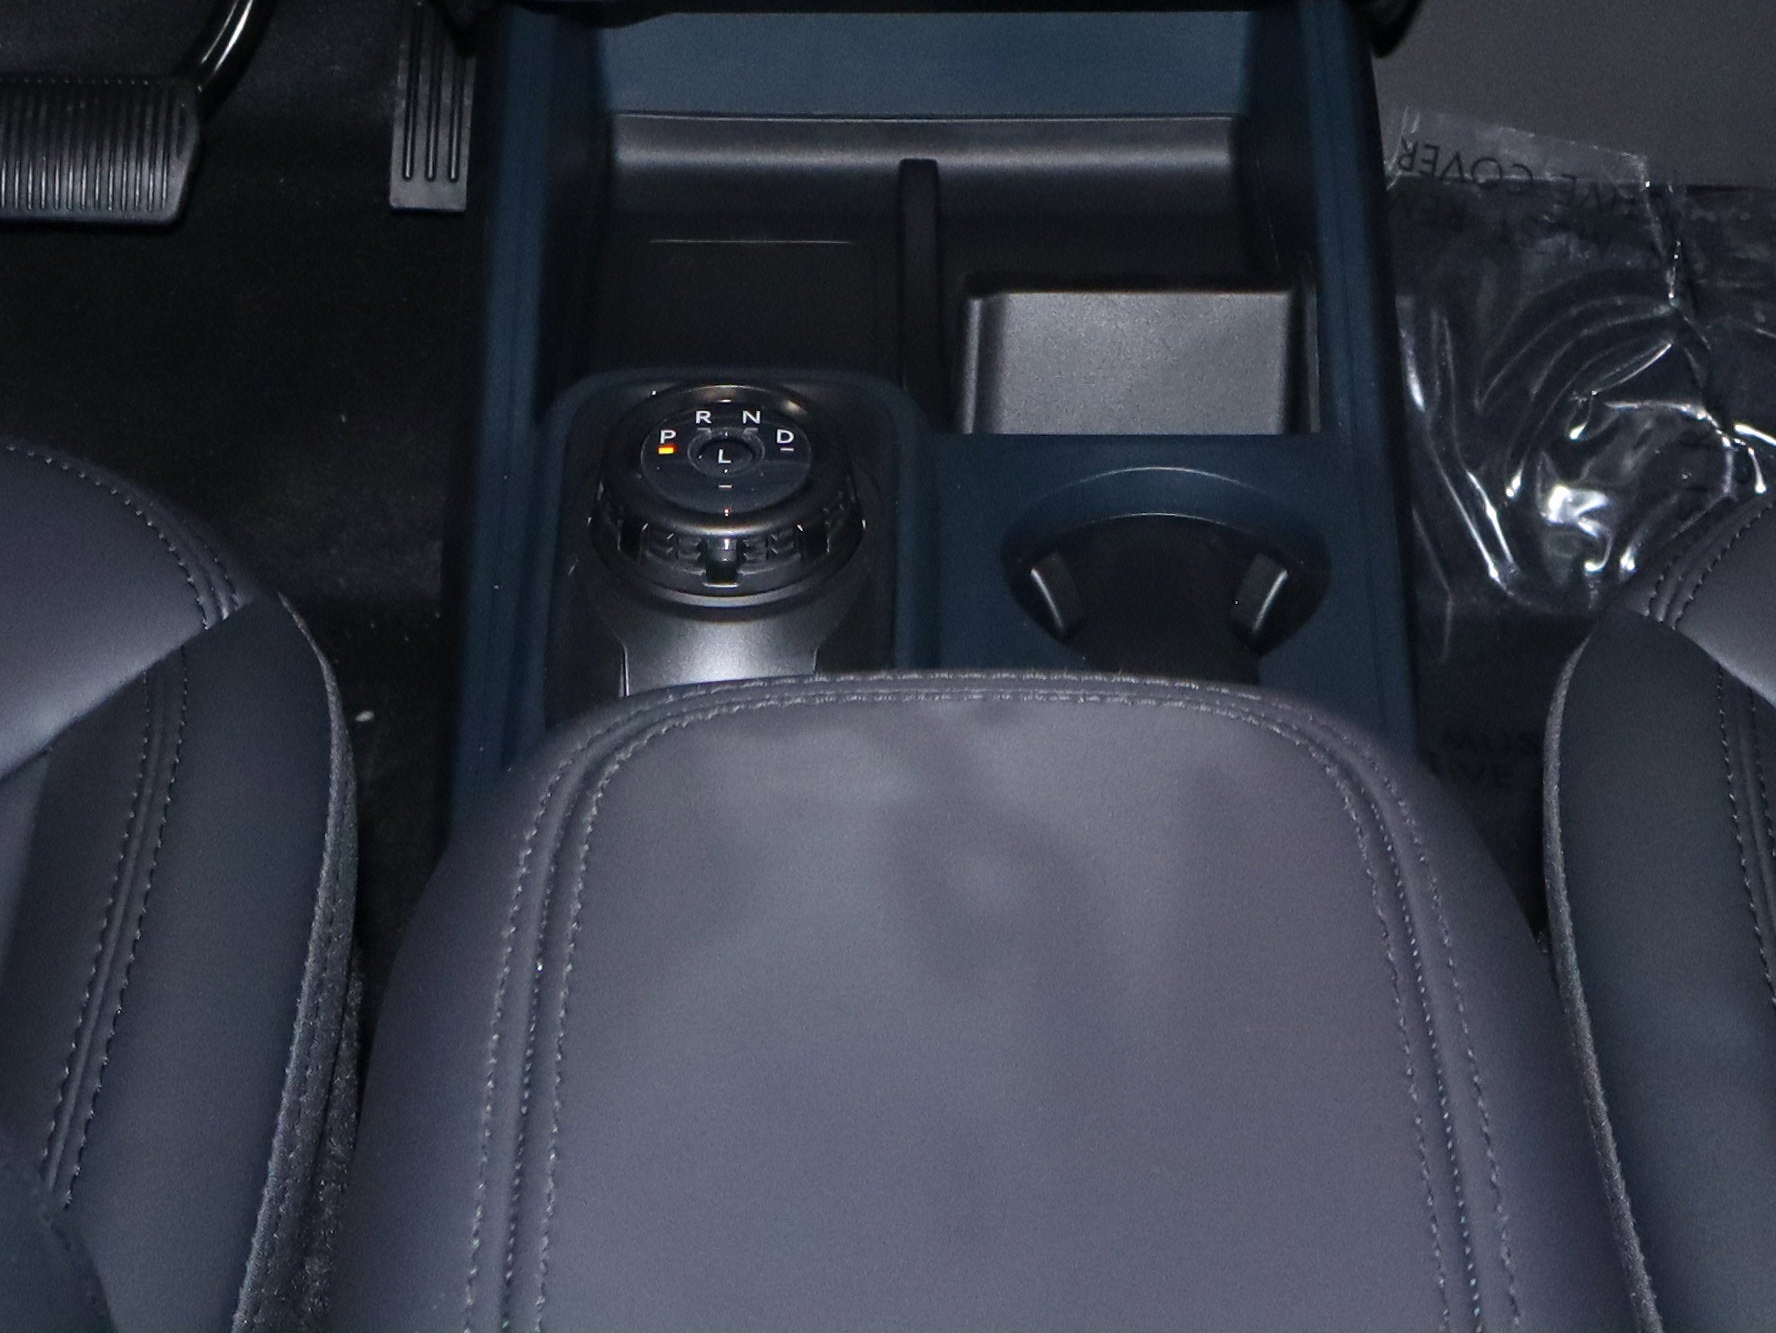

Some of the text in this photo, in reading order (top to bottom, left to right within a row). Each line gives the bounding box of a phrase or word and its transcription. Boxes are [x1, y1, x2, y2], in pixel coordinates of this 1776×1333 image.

[695, 410, 761, 425] R N
[659, 430, 795, 445] P D
[718, 449, 732, 464] L
